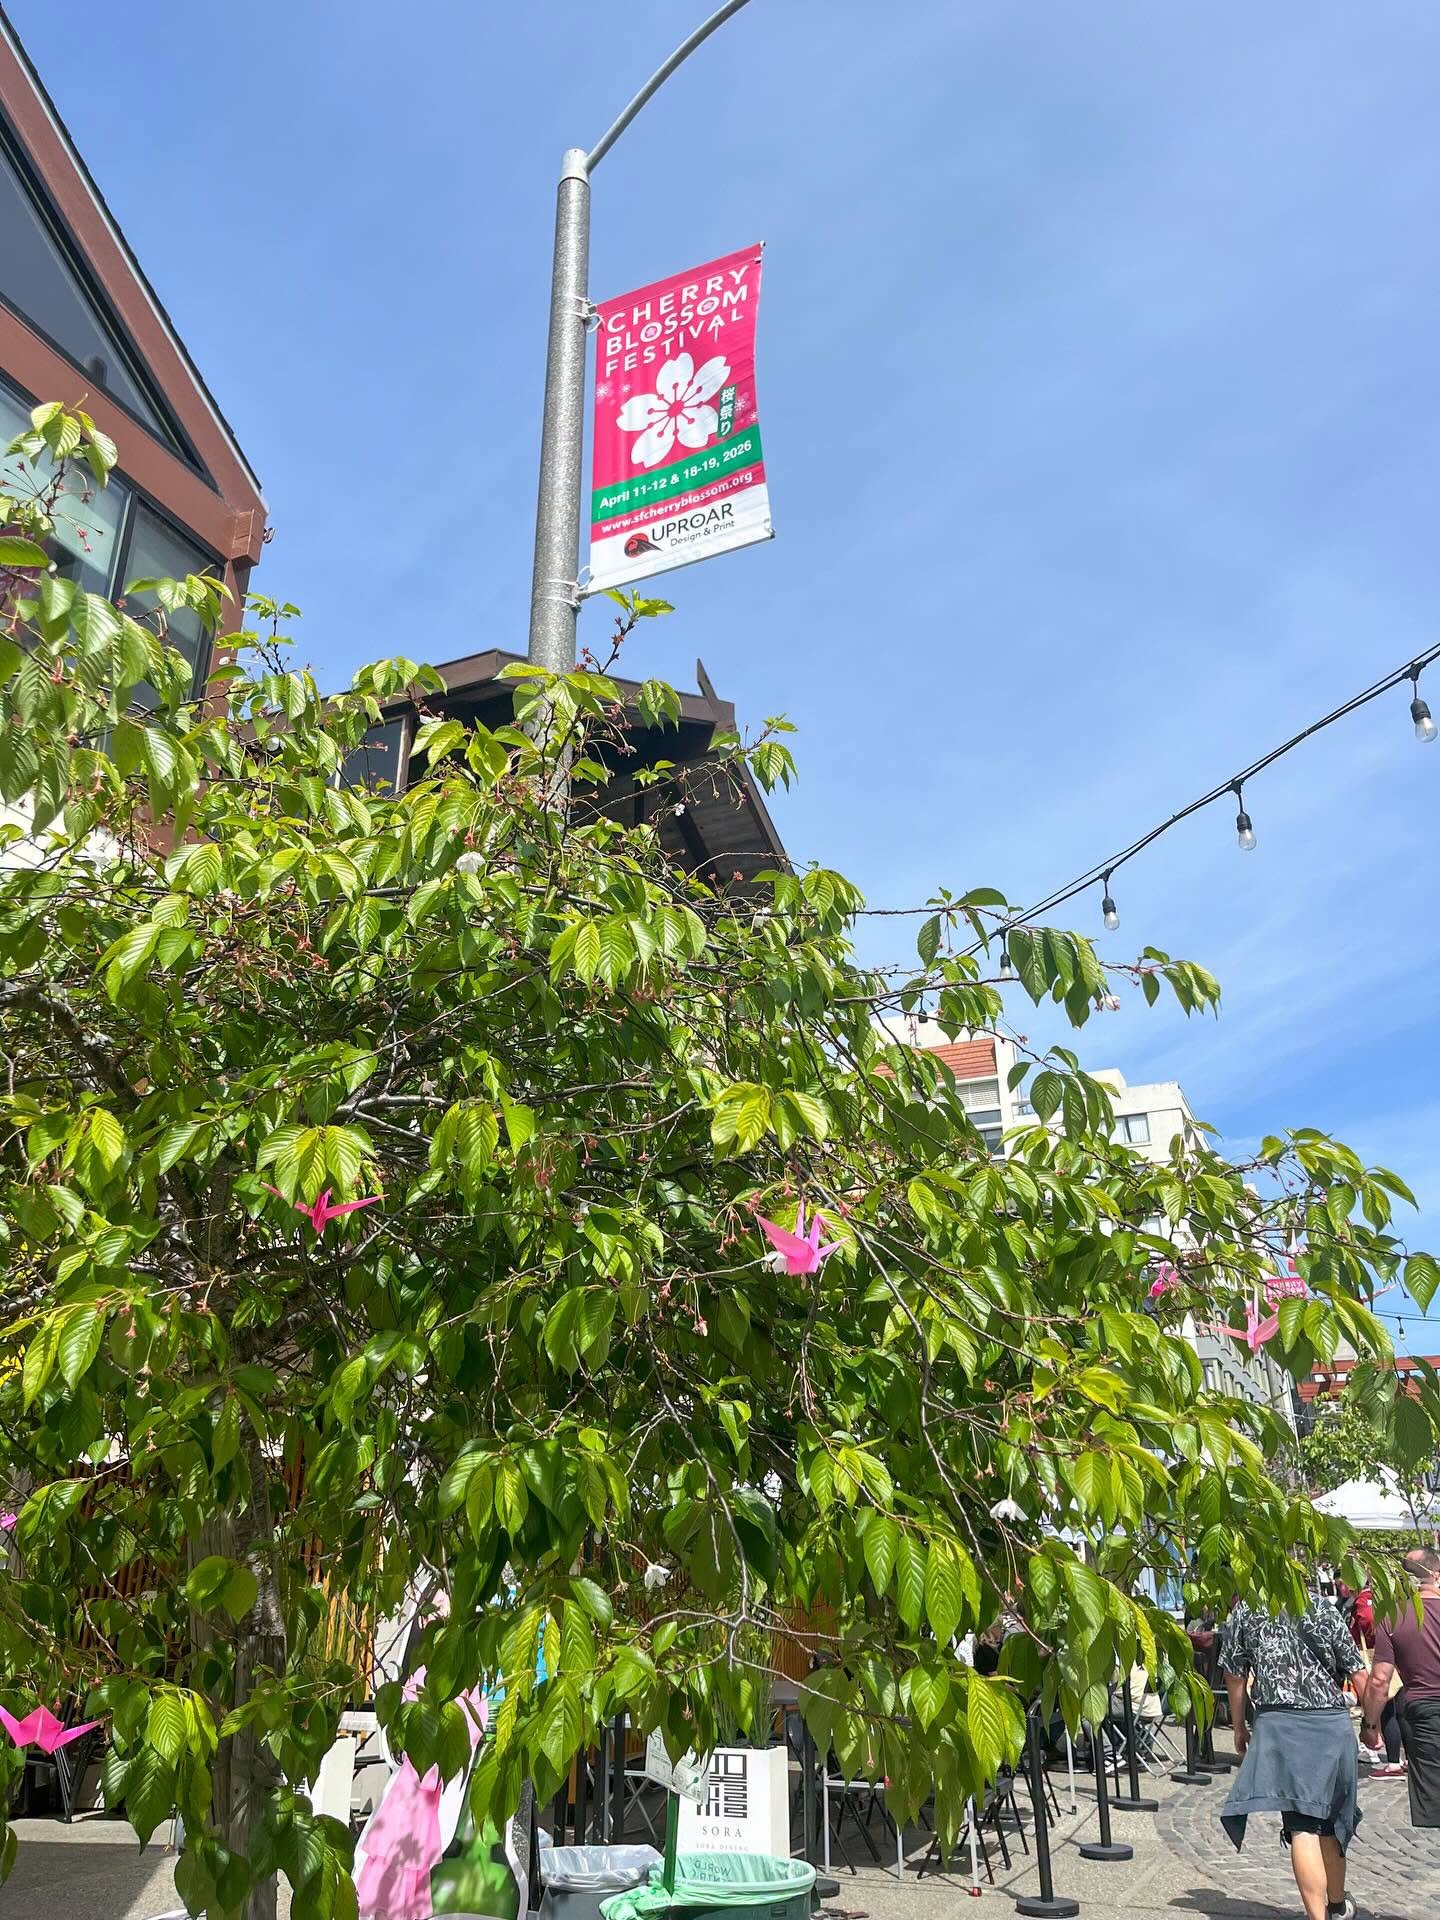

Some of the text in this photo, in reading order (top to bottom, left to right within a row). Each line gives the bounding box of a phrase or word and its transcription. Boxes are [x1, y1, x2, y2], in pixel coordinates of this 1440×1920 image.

[606, 285, 748, 357] BLOSSOM
[607, 265, 749, 333] CHERRY
[606, 308, 744, 378] FESTIVAL
[720, 386, 736, 436] 桜祭り
[600, 439, 752, 509] April 11-12 & 18-19, 2026
[601, 471, 753, 534] www.sfcherryblossom.org
[651, 503, 734, 542] UPROAR
[670, 532, 702, 547] Design
[703, 527, 711, 536] &
[713, 520, 735, 533] Print
[702, 1825, 742, 1838] SORA
